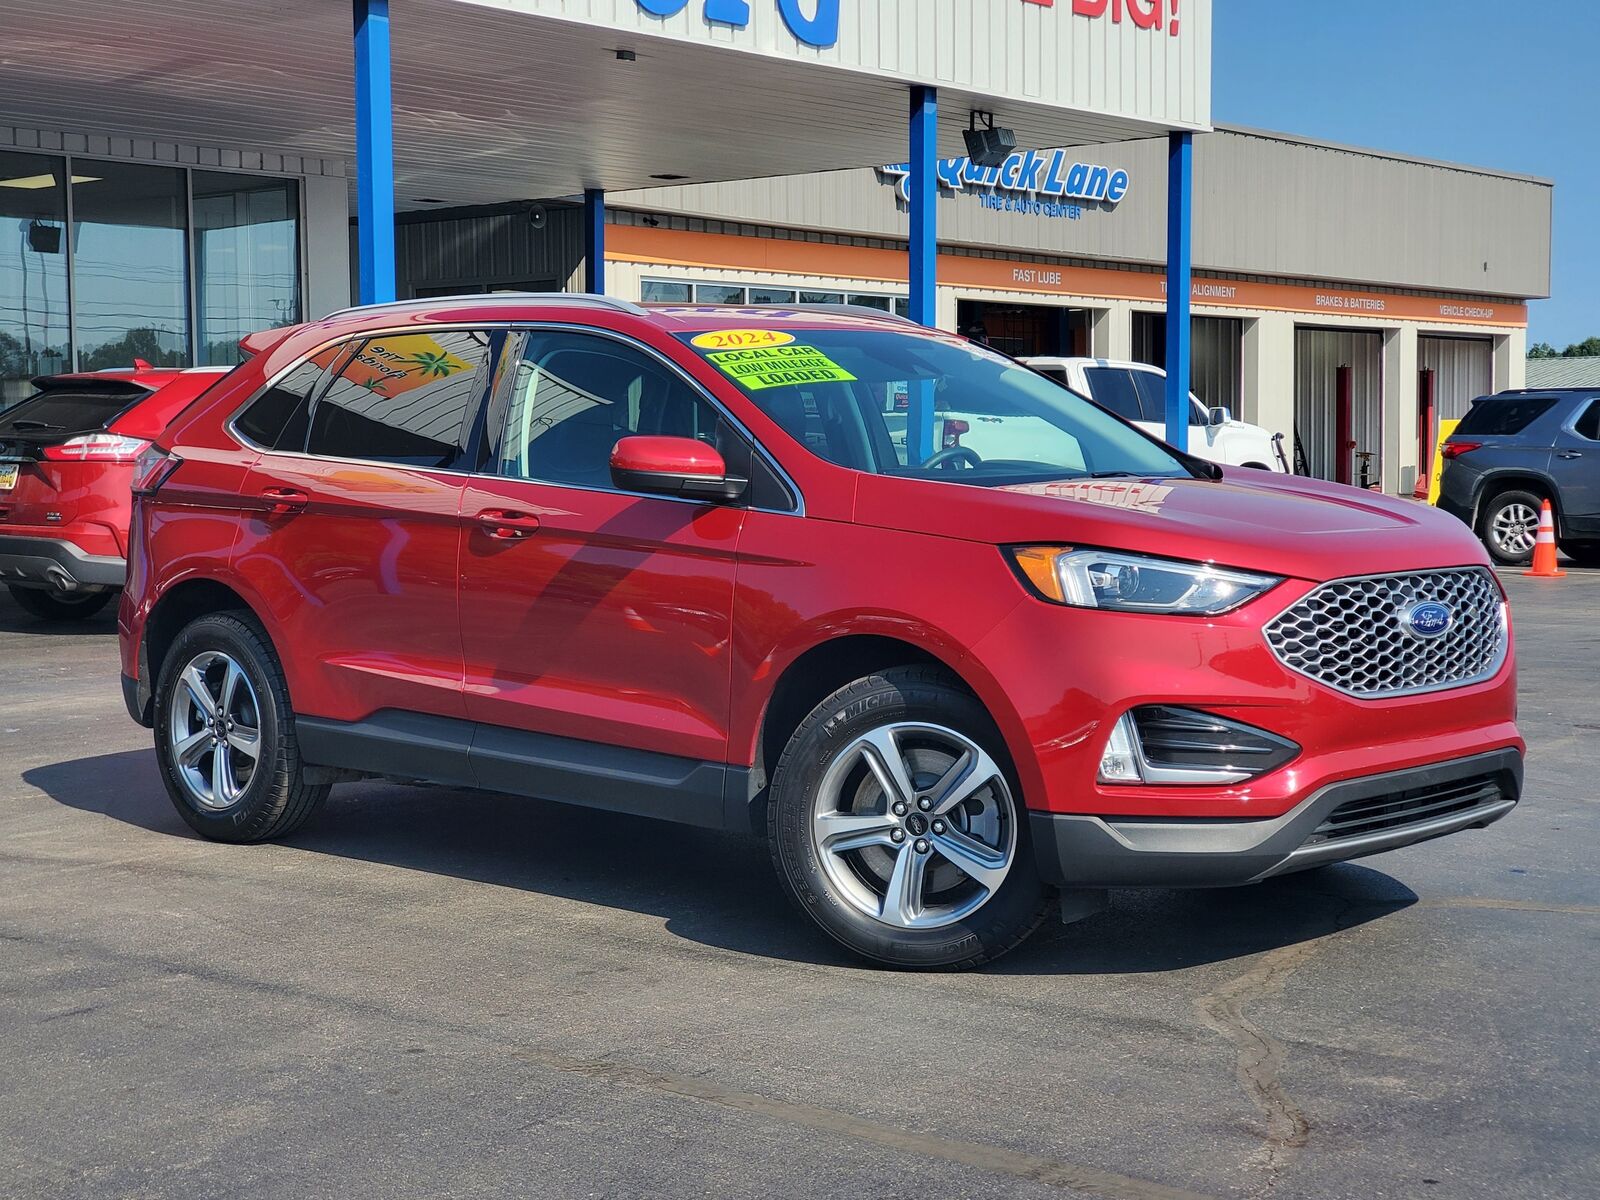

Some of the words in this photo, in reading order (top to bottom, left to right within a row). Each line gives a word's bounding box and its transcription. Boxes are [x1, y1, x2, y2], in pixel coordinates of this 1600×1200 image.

[1041, 147, 1130, 203] Lane
[979, 193, 1002, 210] TIRE
[1005, 195, 1011, 211] &
[1014, 197, 1041, 215] AUTO
[1043, 202, 1081, 220] CENTER
[1012, 268, 1036, 283] FAST
[1037, 270, 1062, 285] LUBE
[1191, 284, 1237, 298] ALIGNMENT
[1315, 295, 1343, 308] BRAKES
[1350, 297, 1385, 311] BATTERIES
[1439, 304, 1464, 316] VEHICLE
[1464, 306, 1494, 319] CHECK-UP
[711, 331, 777, 348] 2024
[713, 348, 778, 363] LOCAL
[777, 346, 818, 357] CAR
[730, 361, 765, 375] LOW
[765, 358, 828, 371] MILEAGE
[755, 369, 838, 386] LOADED
